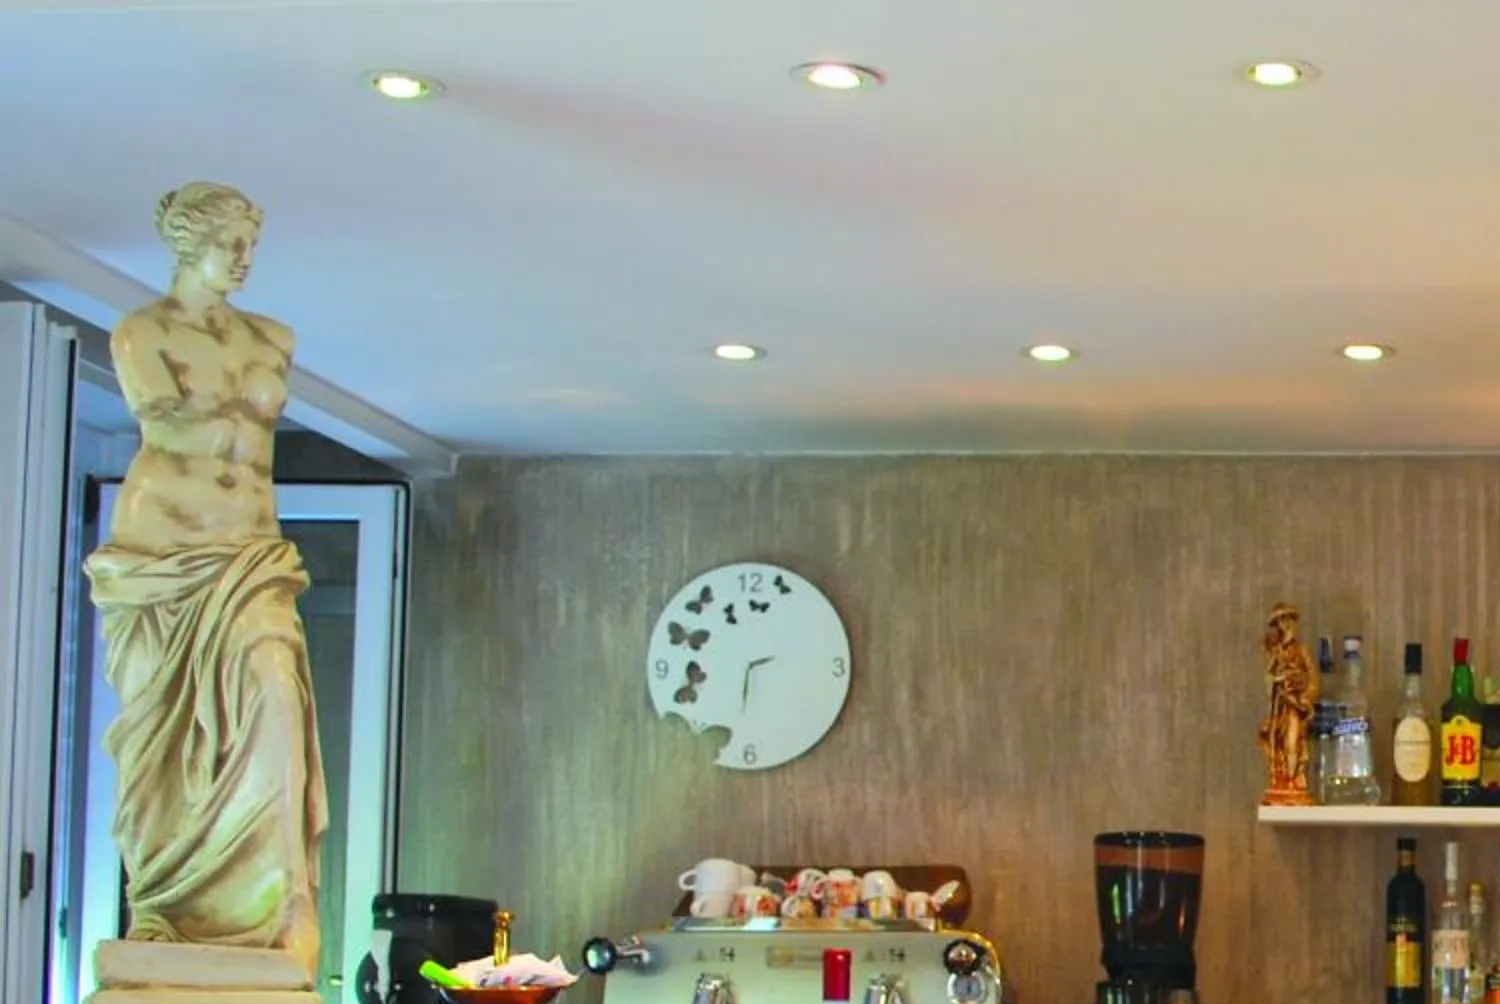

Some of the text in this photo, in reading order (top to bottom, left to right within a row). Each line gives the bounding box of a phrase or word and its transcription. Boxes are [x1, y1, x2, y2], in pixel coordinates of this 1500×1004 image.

[737, 573, 764, 593] 12
[655, 659, 669, 680] 9
[831, 657, 847, 679] 3
[743, 744, 757, 764] 6
